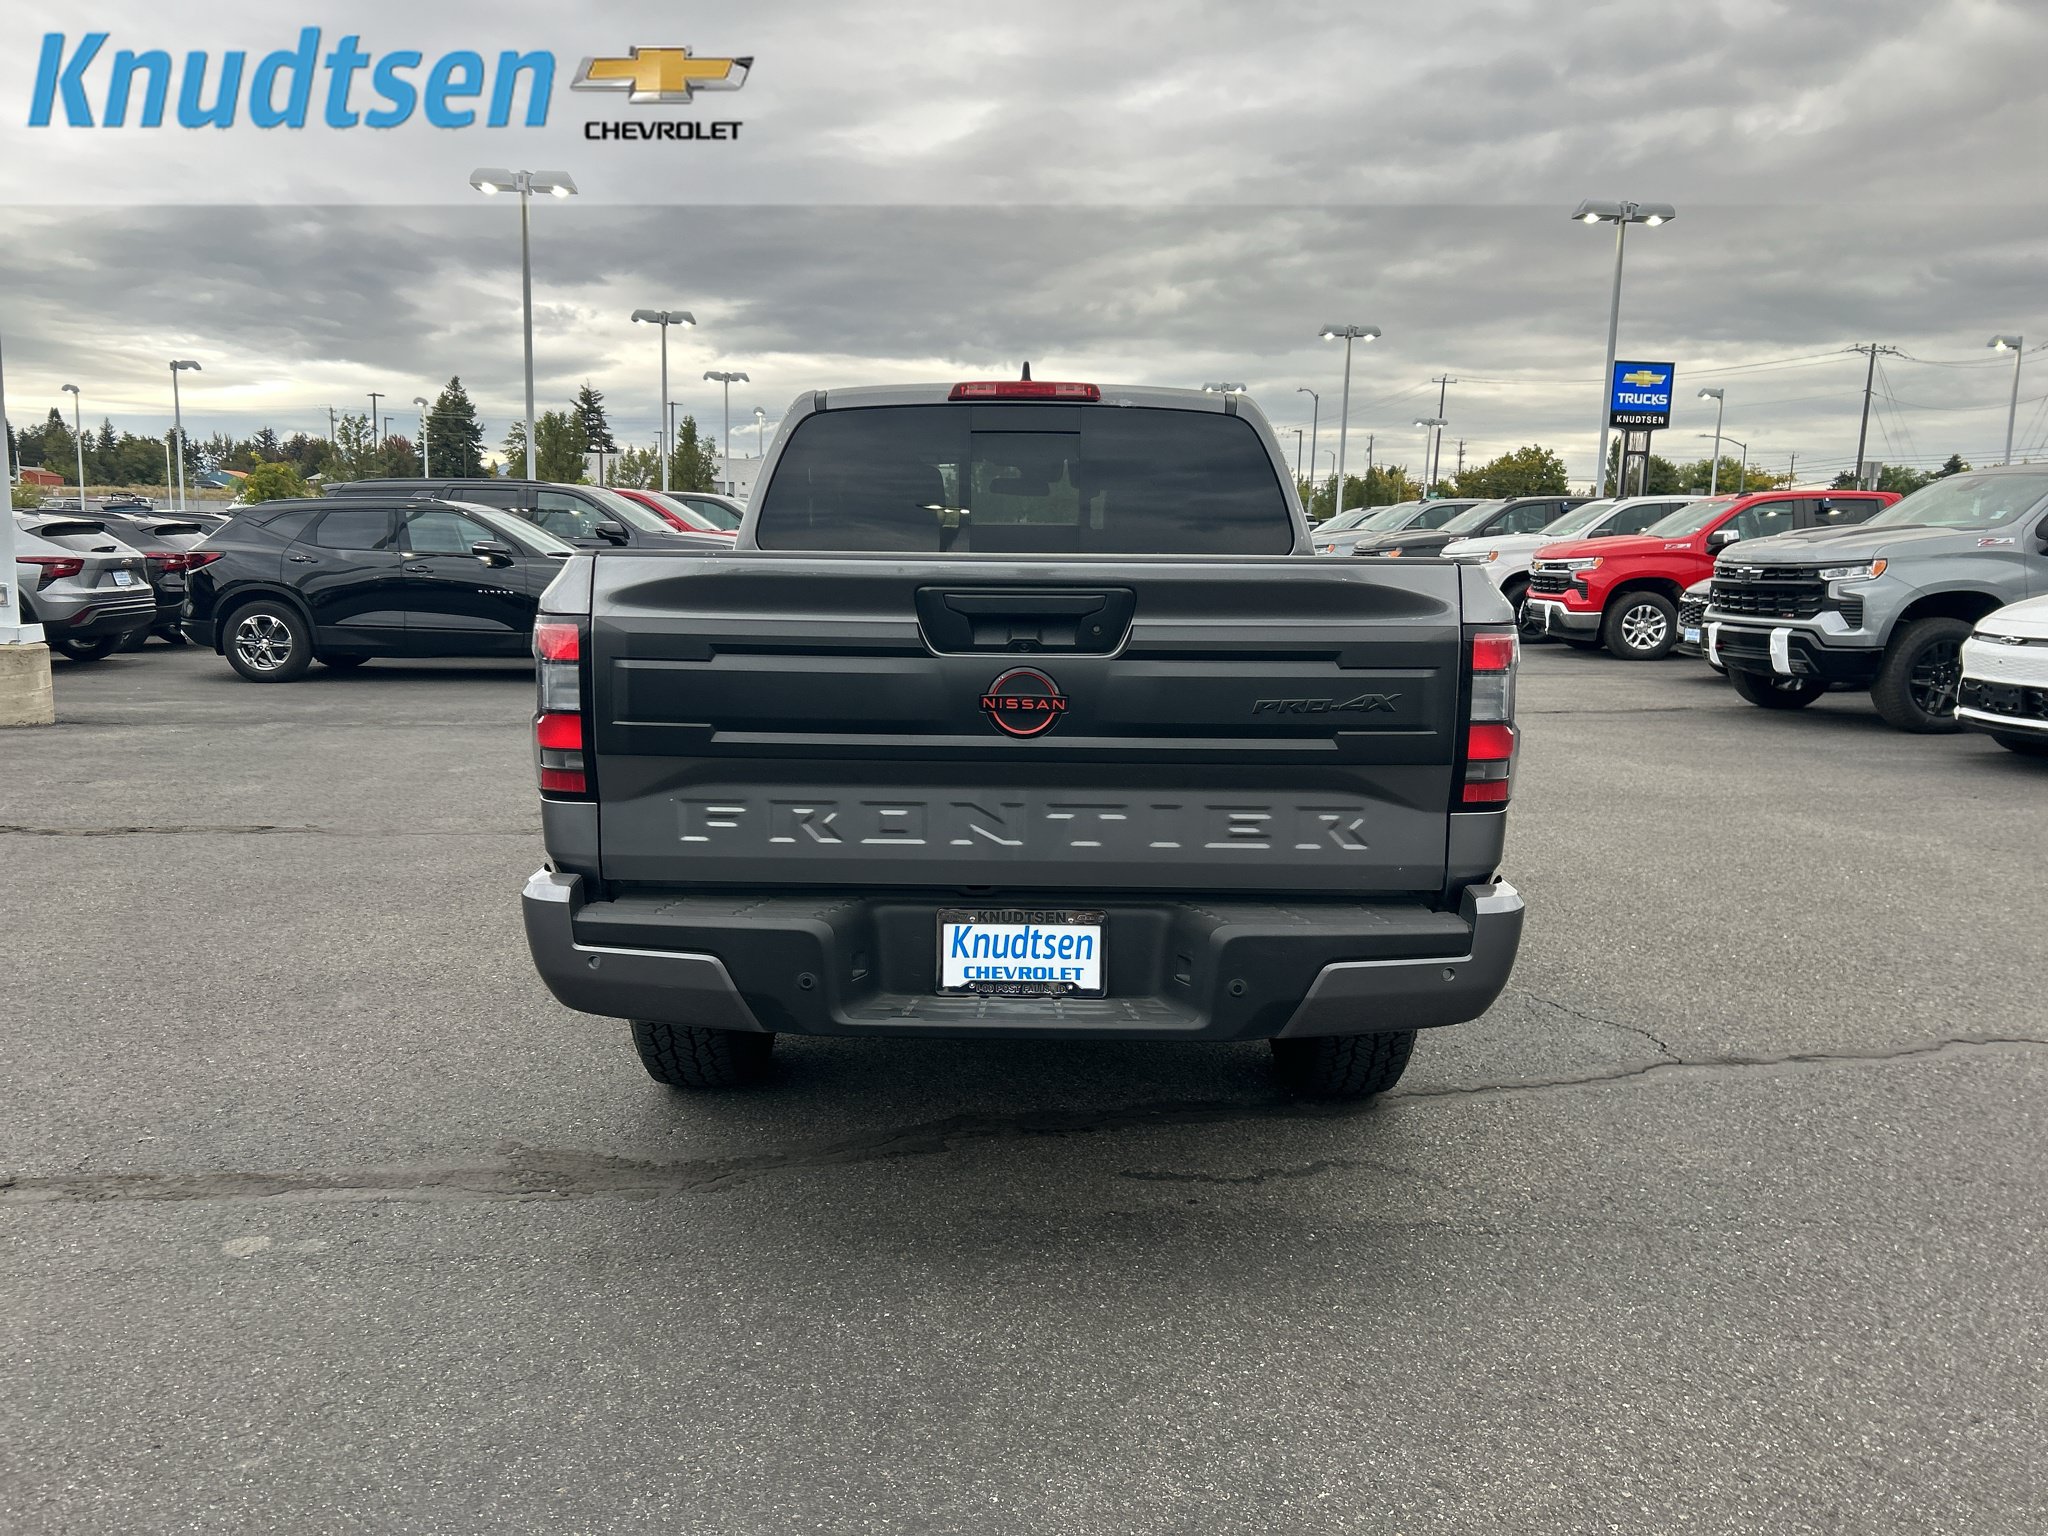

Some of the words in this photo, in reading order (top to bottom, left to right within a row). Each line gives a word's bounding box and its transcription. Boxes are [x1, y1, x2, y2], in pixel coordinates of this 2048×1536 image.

[1618, 393, 1668, 405] TRUCKS
[1616, 415, 1664, 424] KNUDTSEN
[983, 698, 1065, 710] NISSAN
[1252, 693, 1402, 714] PRO-4X
[680, 799, 1368, 850] FRONTIER
[977, 911, 1067, 923] KNUDTSEN
[951, 925, 1093, 960] Knudtsen
[963, 966, 1084, 981] CHEVROLET
[996, 983, 1020, 993] POST
